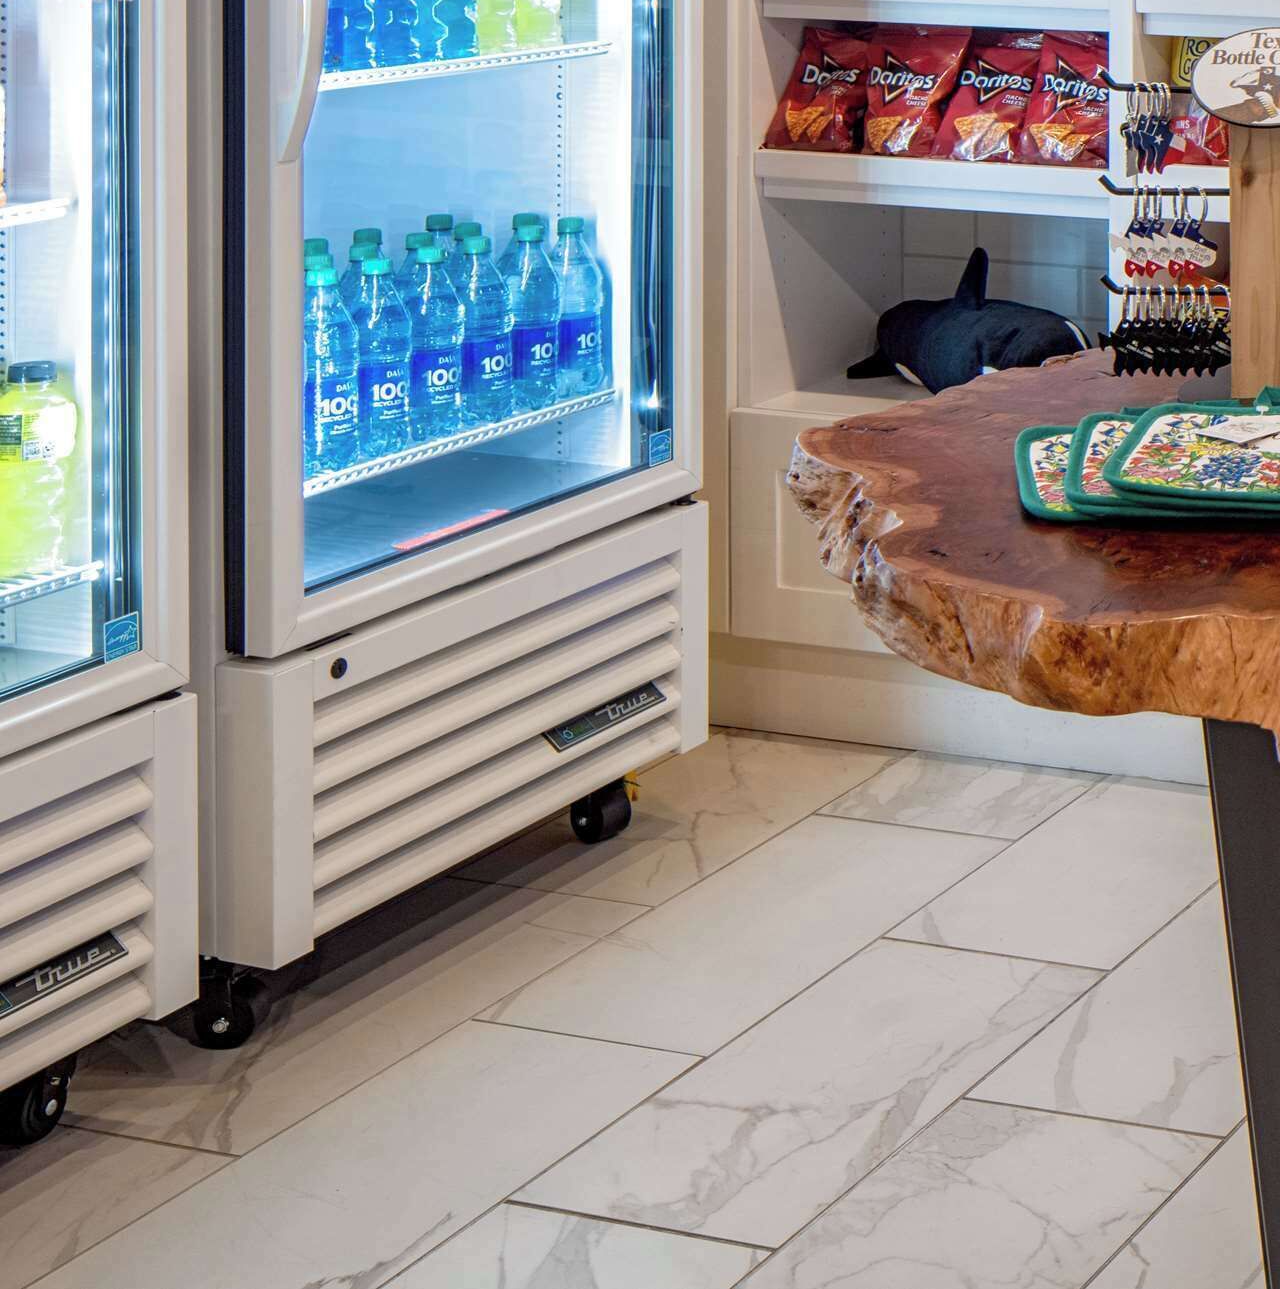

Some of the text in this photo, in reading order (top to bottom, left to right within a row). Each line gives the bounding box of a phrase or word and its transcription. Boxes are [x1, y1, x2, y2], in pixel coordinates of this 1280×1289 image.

[1212, 49, 1266, 66] Bottle
[802, 63, 861, 85] Doritos
[870, 65, 934, 91] Doritos
[958, 68, 1032, 93] Doritos
[1043, 73, 1108, 102] Doritos
[595, 688, 660, 723] true
[16, 945, 118, 993] true
